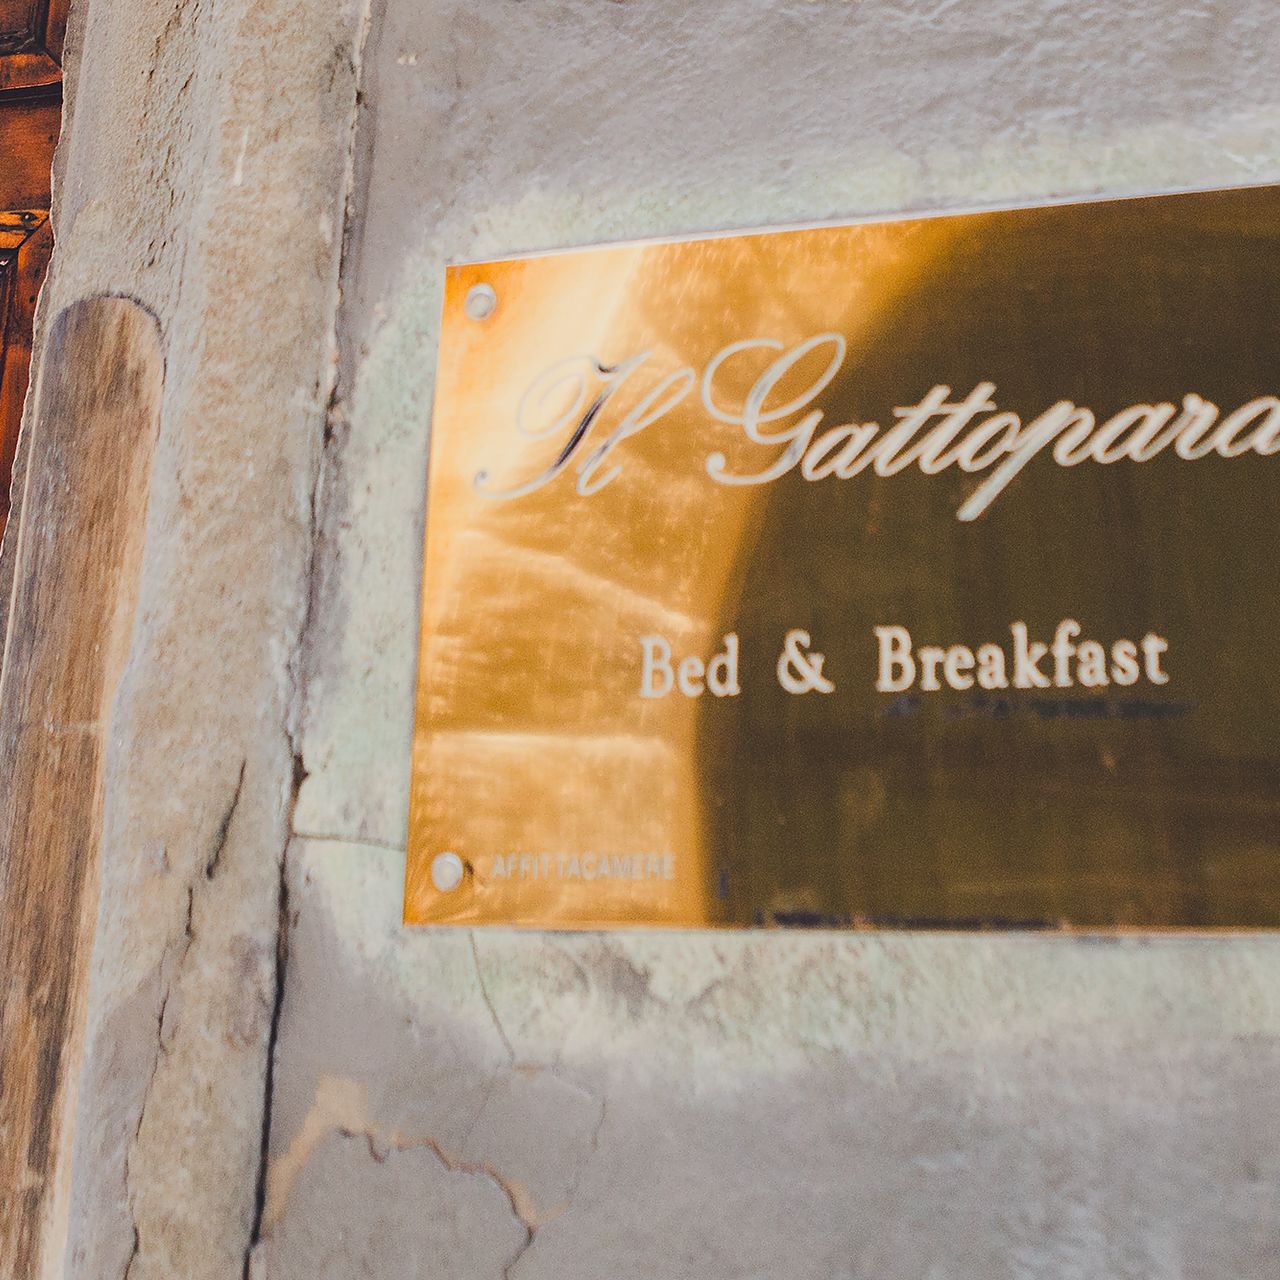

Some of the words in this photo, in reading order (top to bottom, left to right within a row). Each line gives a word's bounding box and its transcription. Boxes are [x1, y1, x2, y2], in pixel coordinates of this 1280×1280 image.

[473, 349, 696, 501] Il
[638, 634, 741, 699] Bed
[775, 629, 834, 694] &
[873, 617, 1170, 694] Breakfast
[490, 852, 678, 882] AFFITTACAMERE
